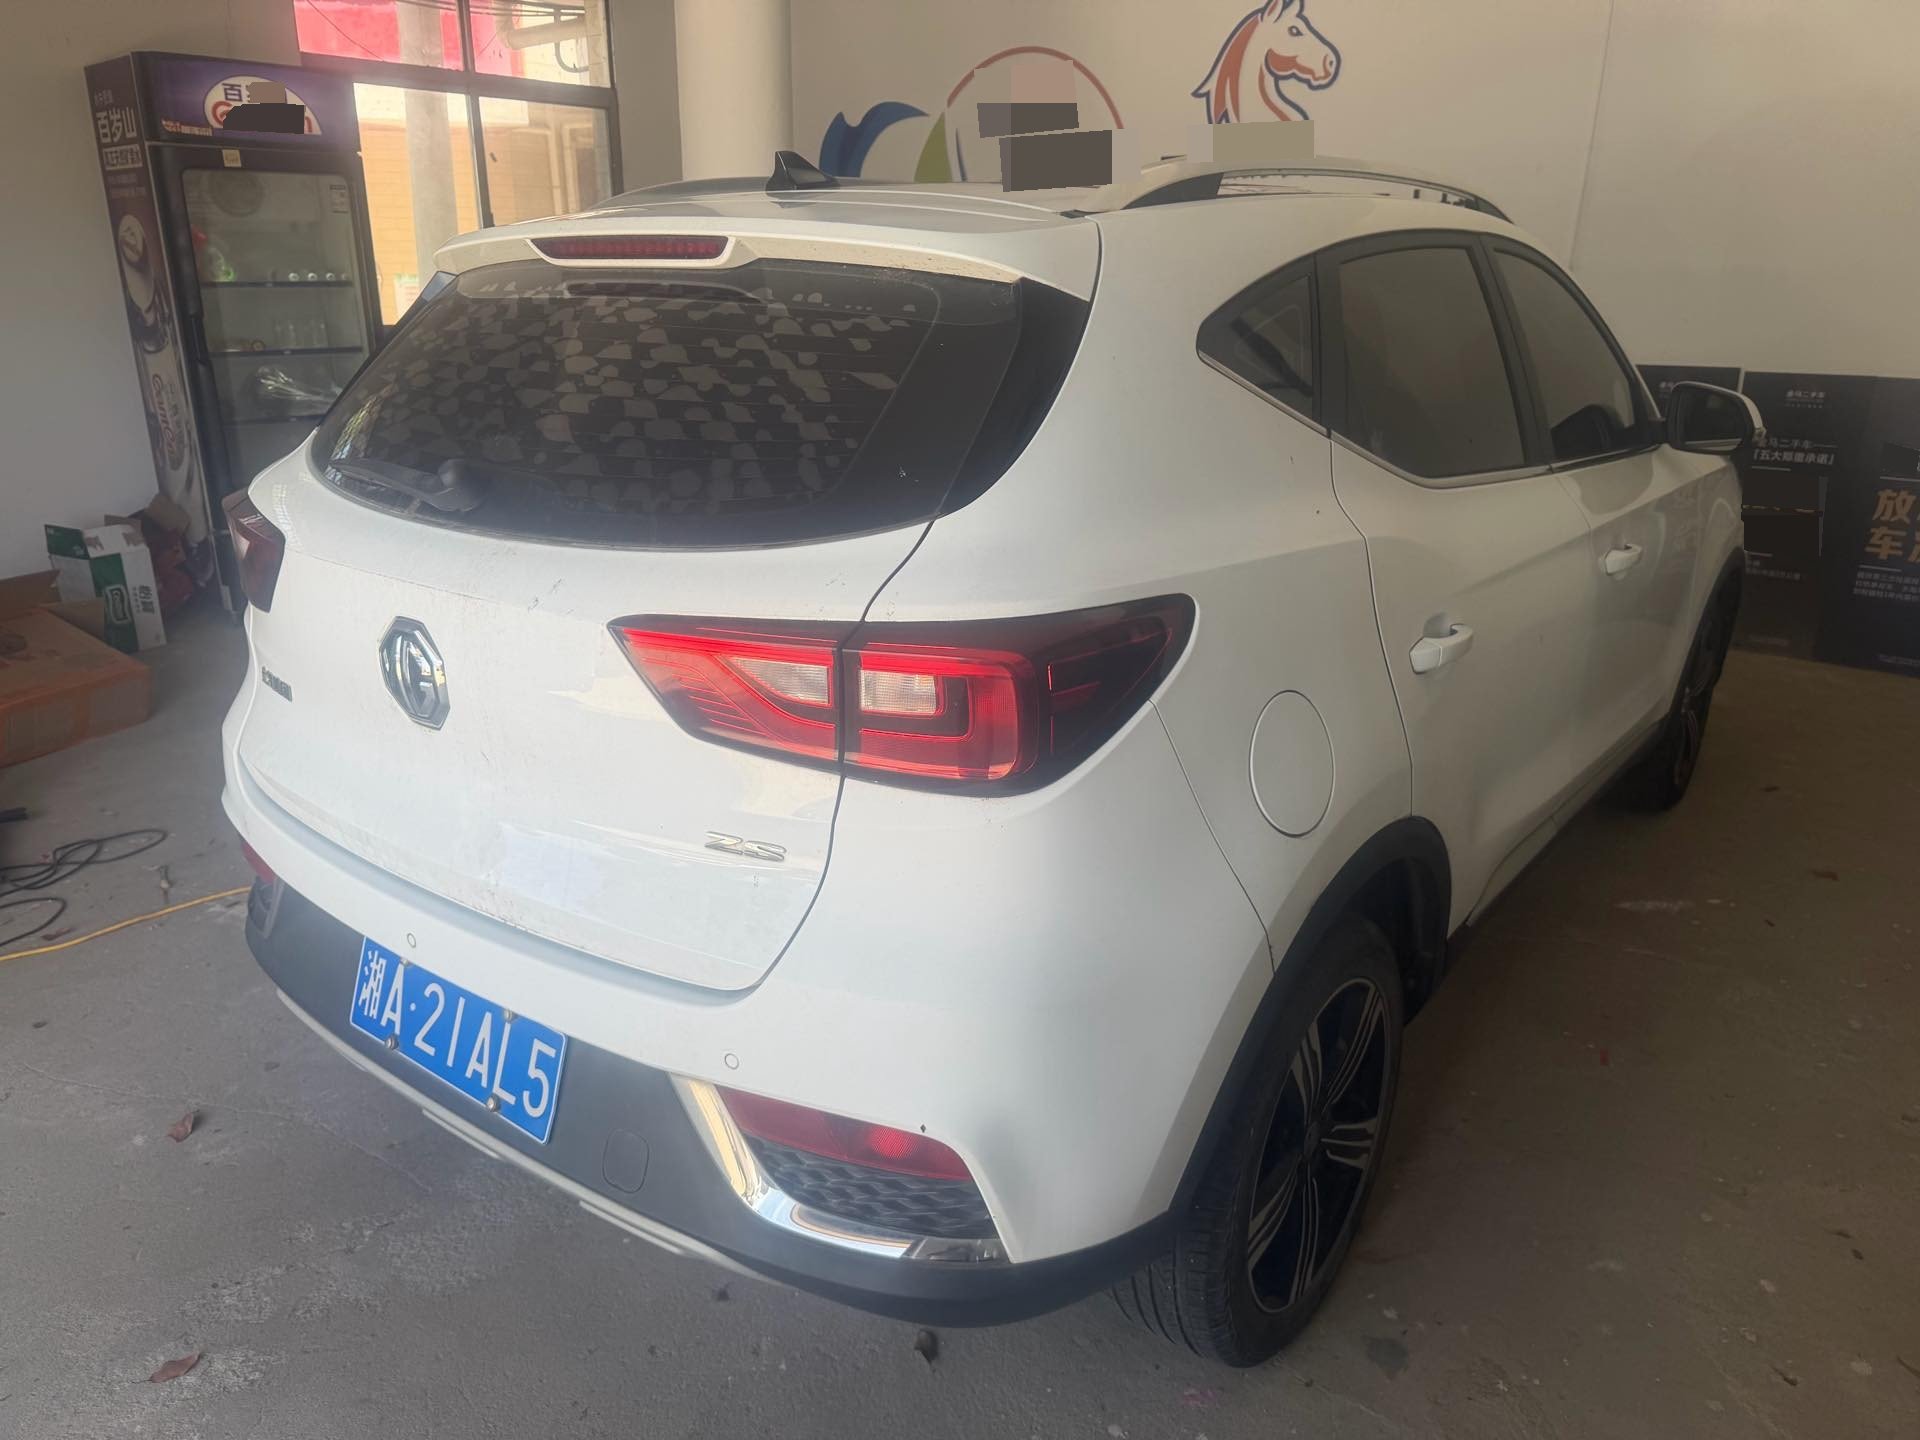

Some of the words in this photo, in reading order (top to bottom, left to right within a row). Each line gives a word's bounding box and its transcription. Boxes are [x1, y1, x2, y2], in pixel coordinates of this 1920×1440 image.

[96, 107, 138, 144] 百岁山
[1871, 488, 1920, 525] 放
[703, 830, 788, 862] ZS
